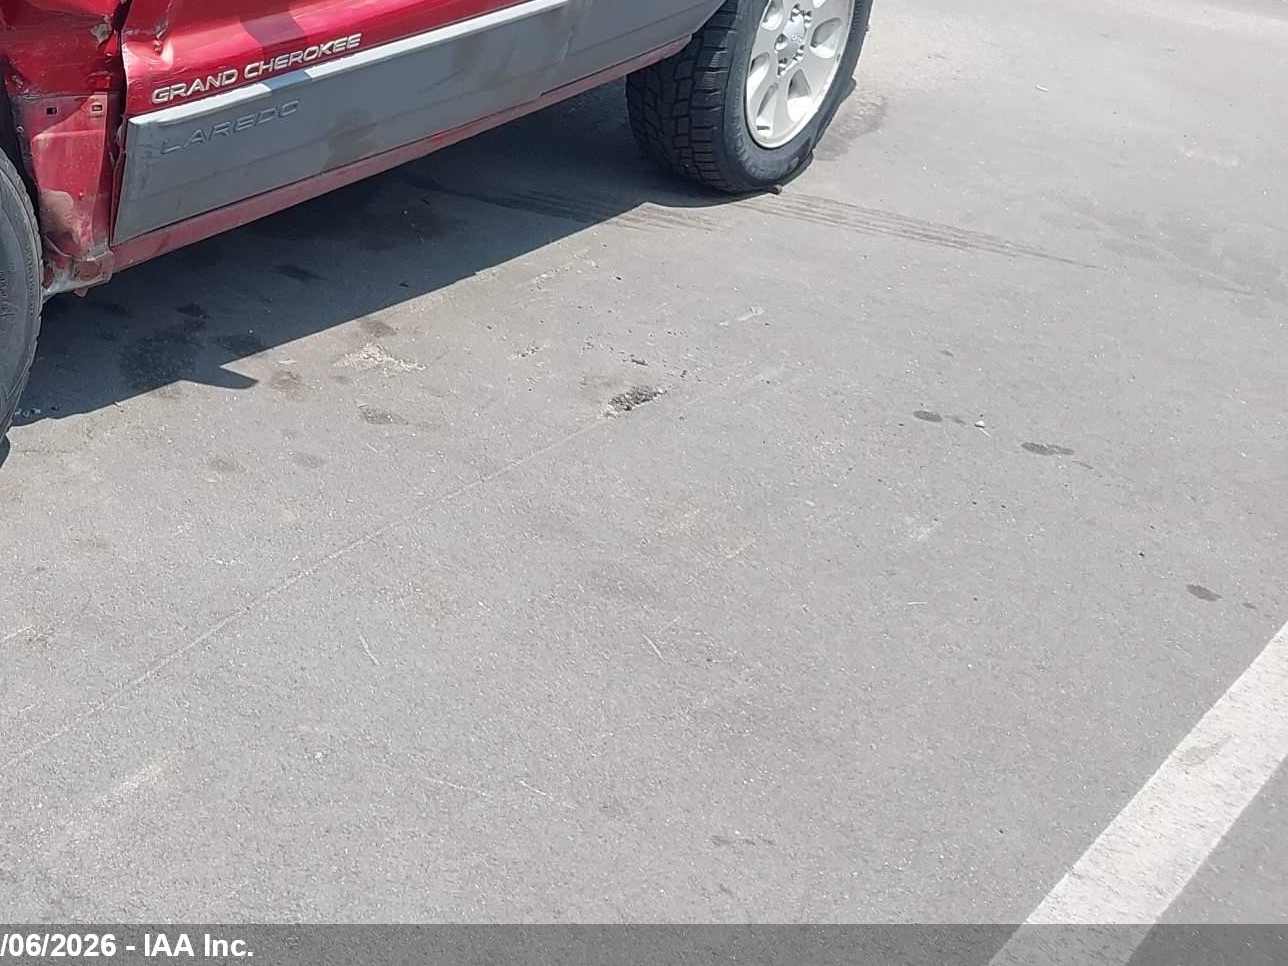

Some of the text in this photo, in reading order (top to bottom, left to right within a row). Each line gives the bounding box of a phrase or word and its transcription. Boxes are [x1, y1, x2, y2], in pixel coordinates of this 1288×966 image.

[152, 33, 362, 104] GRAND CHEROKEE
[160, 99, 300, 155] LAREDO
